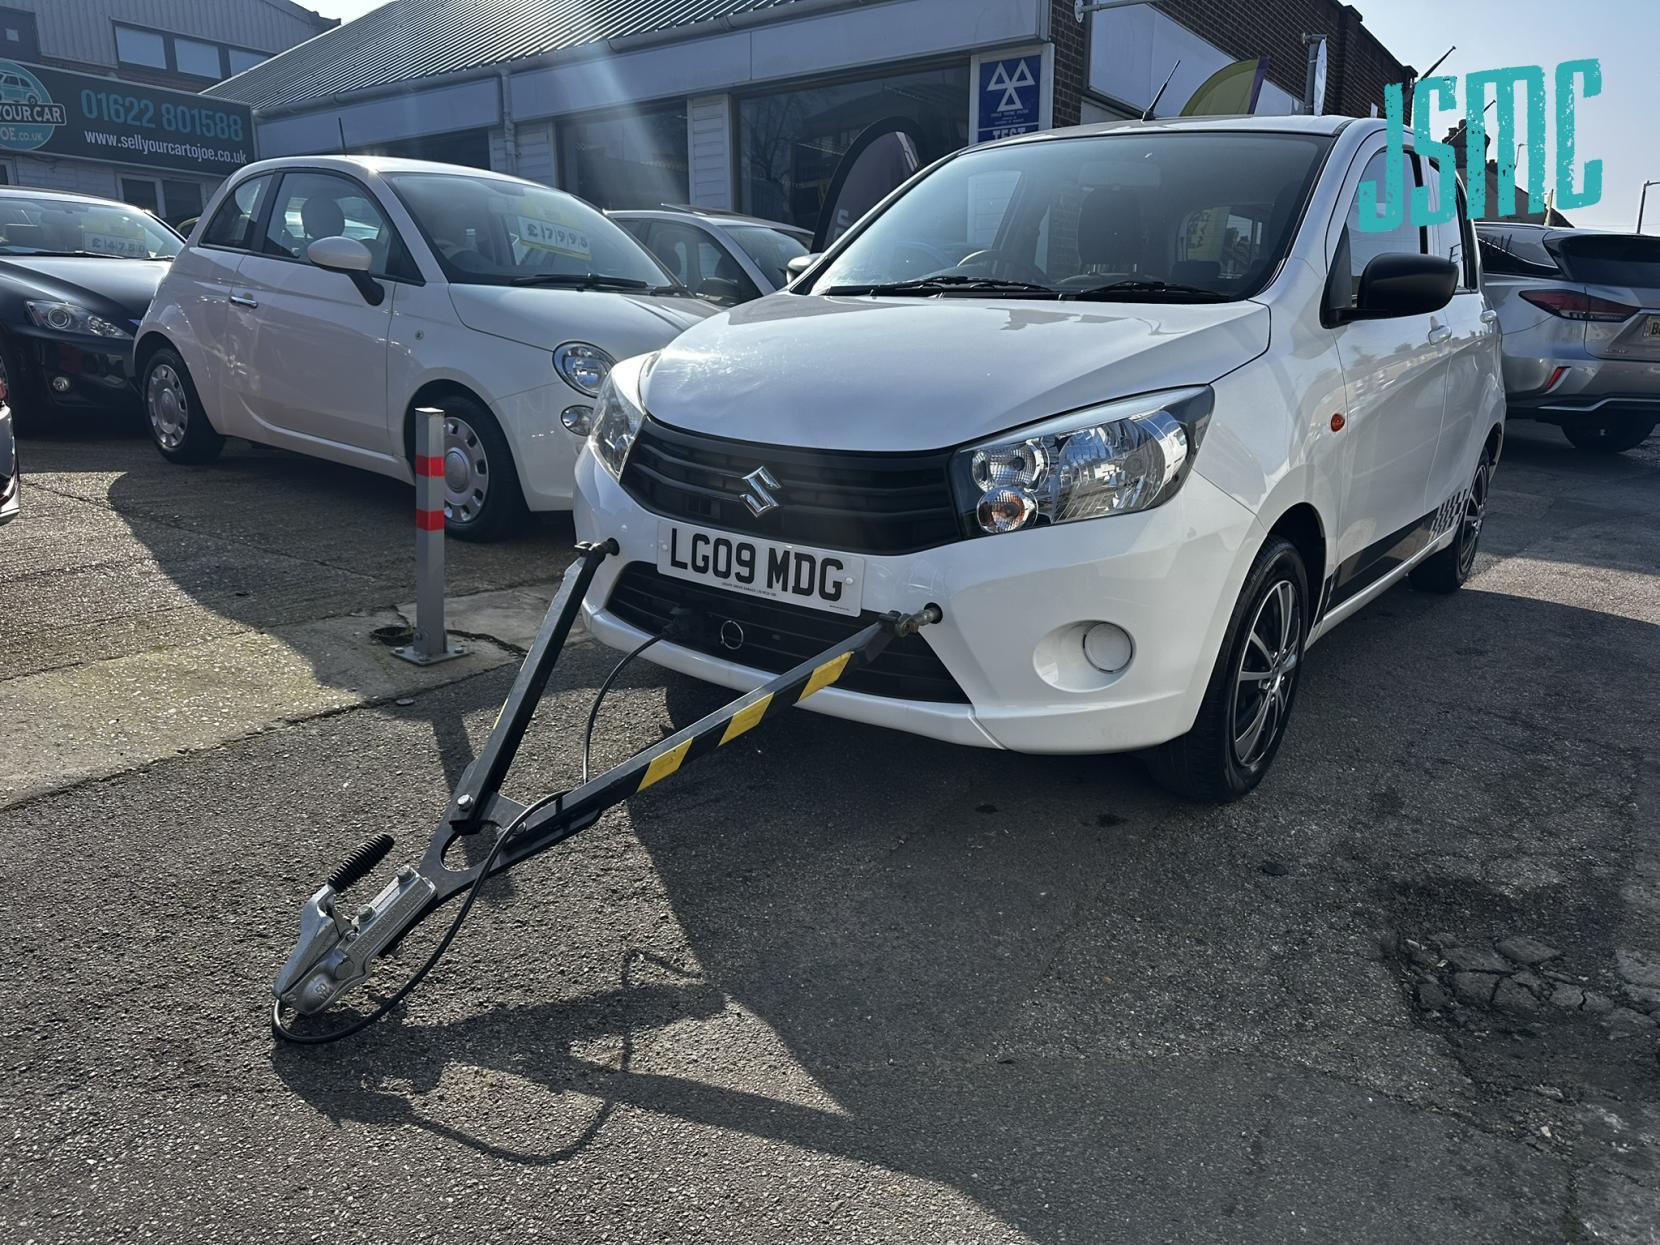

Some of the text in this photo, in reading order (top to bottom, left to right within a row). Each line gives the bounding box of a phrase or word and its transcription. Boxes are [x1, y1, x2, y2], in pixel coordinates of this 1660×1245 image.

[33, 106, 62, 122] CAR
[81, 89, 244, 142] 01622 801588
[84, 130, 247, 165] www.sellyourcartojoe.co.uk
[670, 527, 844, 602] LG09 MDG
